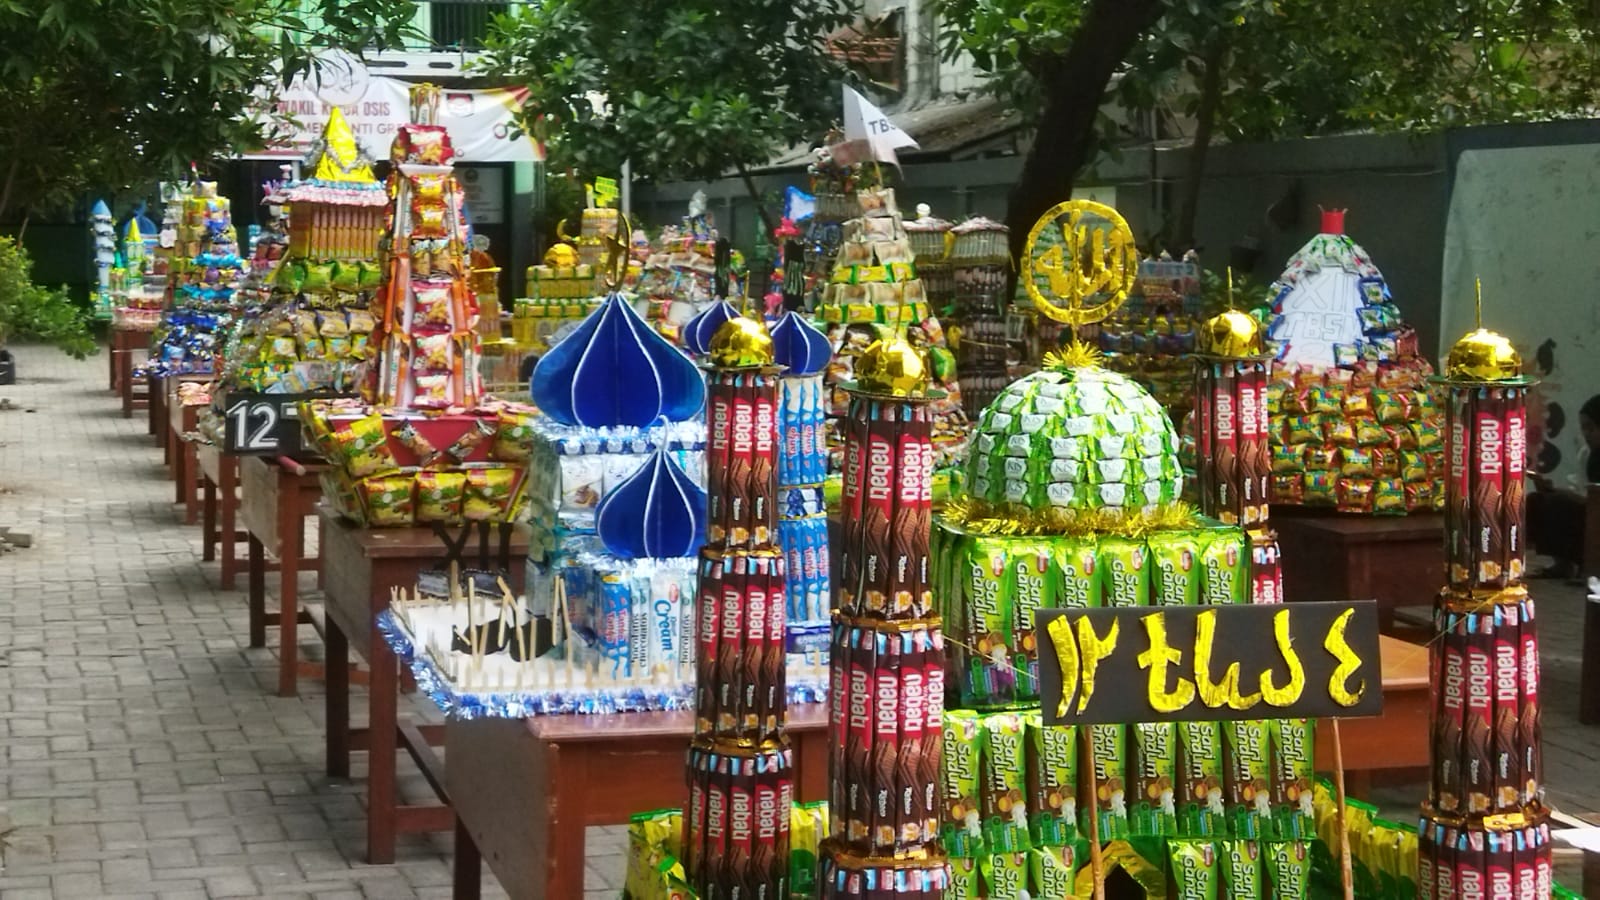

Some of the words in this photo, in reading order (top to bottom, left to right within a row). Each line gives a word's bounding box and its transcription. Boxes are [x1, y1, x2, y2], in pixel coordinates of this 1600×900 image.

[364, 102, 390, 116] OSIS
[227, 400, 278, 449] 12
[713, 402, 728, 449] nabati
[734, 405, 752, 452] nabati
[757, 404, 772, 451] nabati
[1217, 395, 1235, 439] nabati
[1242, 389, 1258, 434] nabati
[847, 440, 860, 497] nabati
[1451, 423, 1465, 478] nabati
[1480, 419, 1502, 473] nabati
[1510, 418, 1522, 472] nabati
[870, 442, 891, 499] nabati
[902, 443, 921, 500] nabati
[702, 595, 717, 642] nabati
[723, 591, 741, 638] nabati
[748, 592, 765, 639] nabati
[772, 593, 783, 640] nabati
[972, 566, 987, 633] Gandum
[985, 580, 999, 615] Sari
[1017, 562, 1033, 629] Gandum
[654, 599, 673, 651] Cream
[1445, 655, 1464, 708] nabati
[1469, 654, 1490, 707] nabati
[1496, 646, 1517, 700] nabati
[1525, 640, 1537, 695] nabati
[832, 667, 844, 724] nabati
[851, 670, 870, 727] nabati
[878, 676, 897, 733] nabati
[905, 674, 923, 731] nabati
[927, 671, 943, 727] nabati
[944, 729, 961, 798] Gandum
[958, 743, 973, 779] Sari
[1004, 736, 1017, 771] Sari
[1055, 732, 1070, 768] Sari
[1105, 727, 1118, 761] Sari
[1155, 723, 1168, 760] Sari
[1200, 726, 1215, 760] Sari
[1248, 727, 1263, 761] Sari
[1292, 727, 1307, 761] Sari
[709, 790, 724, 837] nabati
[733, 793, 750, 840] nabati
[760, 791, 775, 838] nabati
